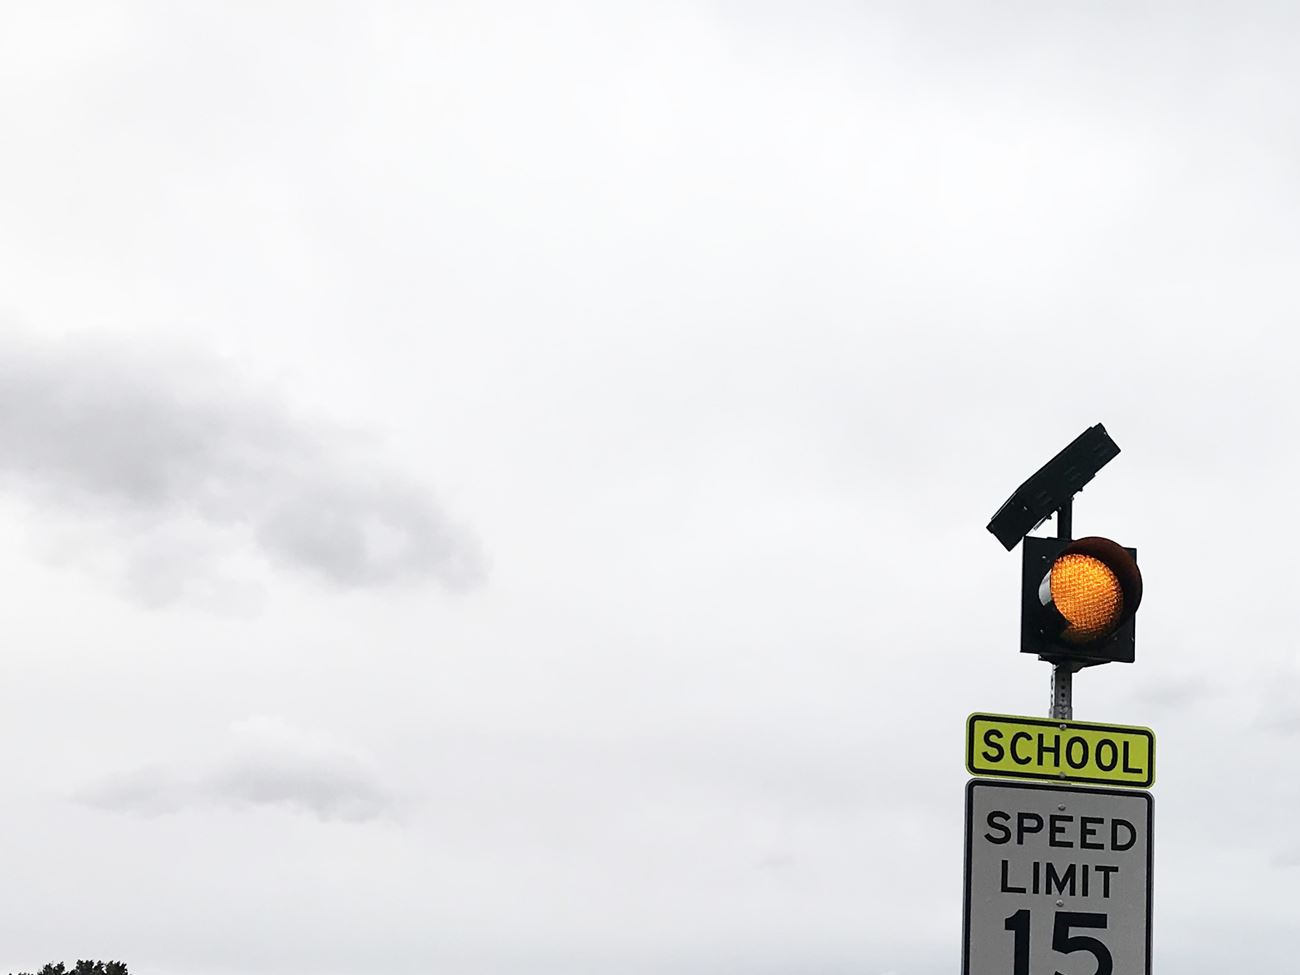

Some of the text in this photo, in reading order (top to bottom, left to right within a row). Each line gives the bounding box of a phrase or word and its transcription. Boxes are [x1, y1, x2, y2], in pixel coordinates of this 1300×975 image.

[982, 729, 1143, 774] SCHOOL
[984, 811, 1137, 851] SPEED
[1001, 860, 1119, 898] LIMIT
